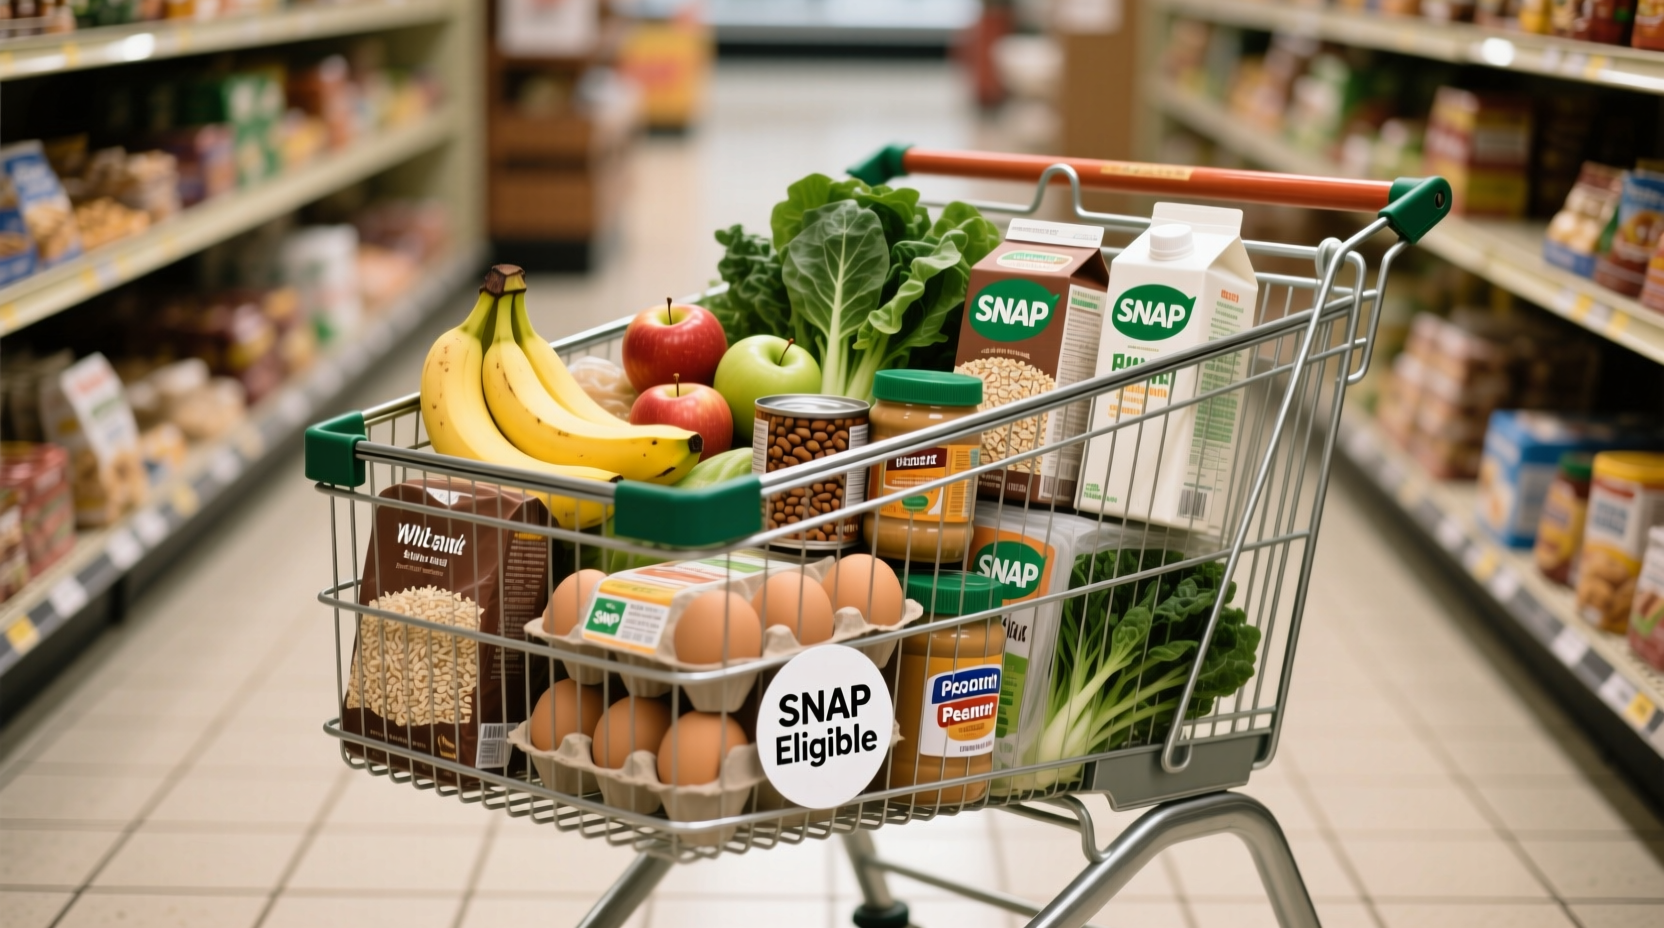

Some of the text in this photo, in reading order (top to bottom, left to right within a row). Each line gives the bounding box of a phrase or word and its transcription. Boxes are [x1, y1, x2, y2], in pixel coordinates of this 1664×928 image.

[975, 294, 1049, 327] SNAP
[1117, 298, 1186, 329] SNAP
[976, 554, 1039, 588] SNAP
[778, 684, 871, 728] SNAP
[776, 723, 878, 767] Eligible
